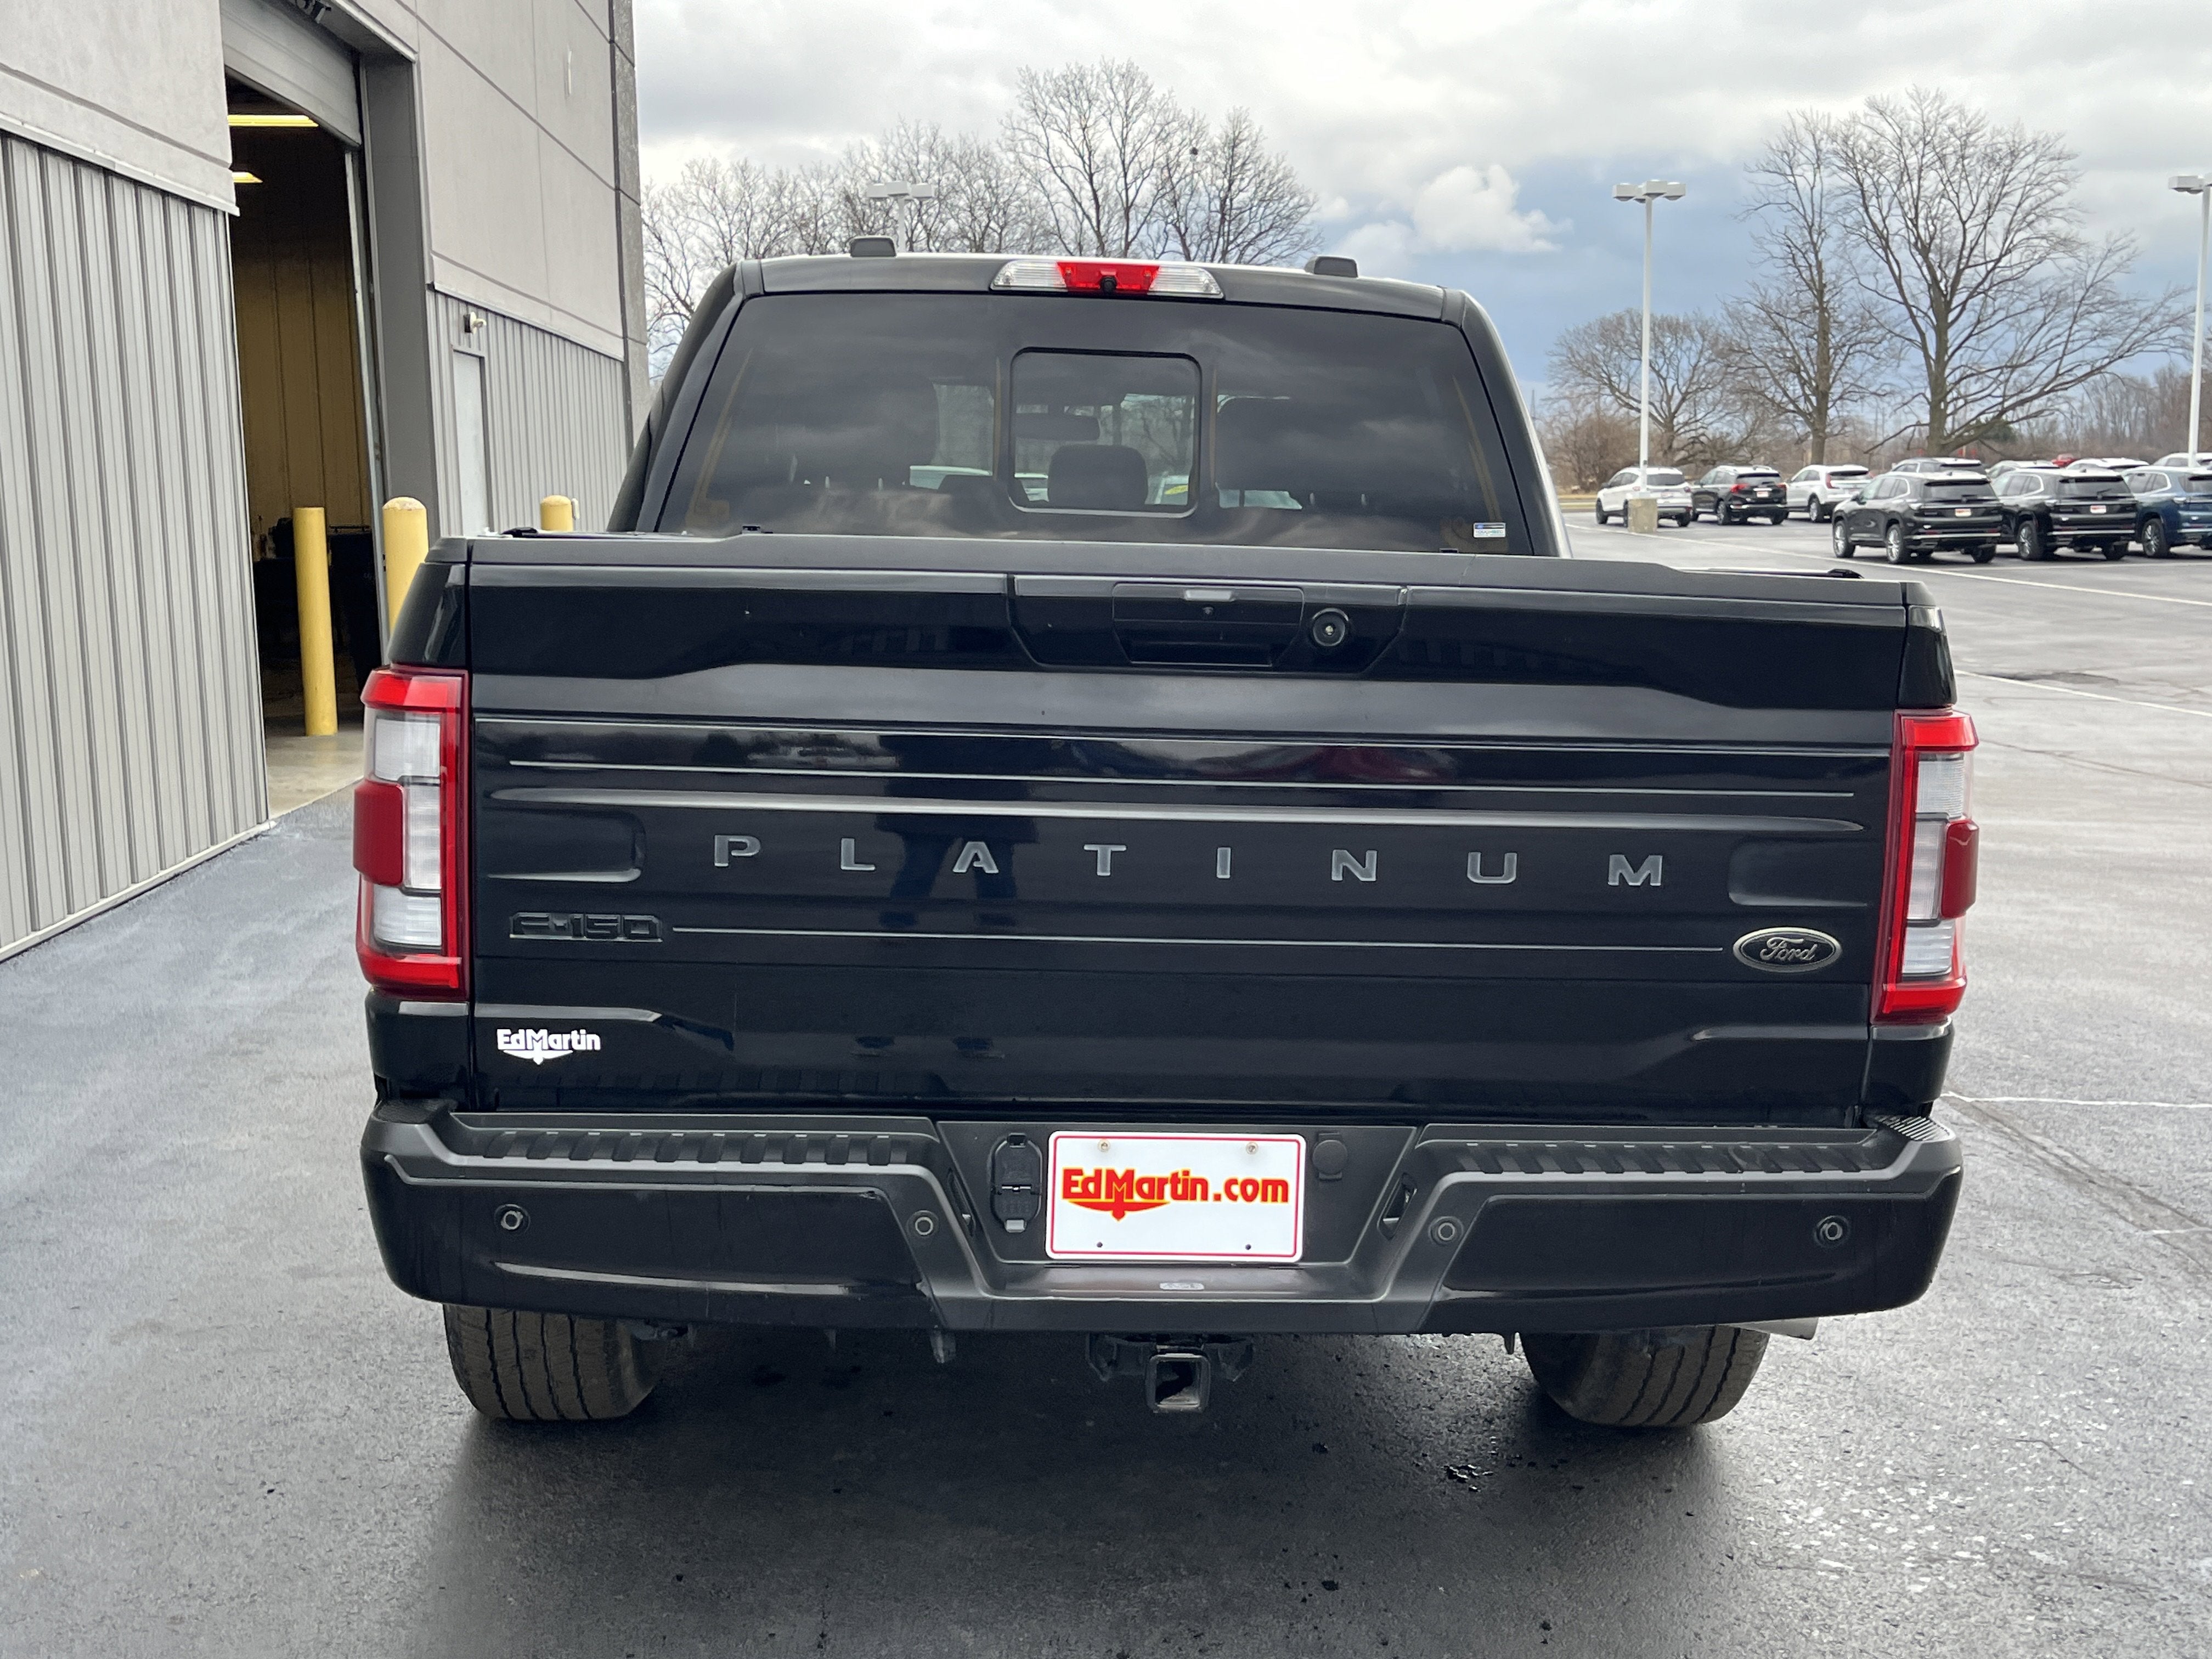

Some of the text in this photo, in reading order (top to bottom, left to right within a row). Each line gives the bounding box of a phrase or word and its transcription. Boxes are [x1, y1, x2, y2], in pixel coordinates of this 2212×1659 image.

[714, 834, 1663, 886] PLATINUM
[1760, 936, 1818, 961] Ford
[496, 1028, 601, 1051] EdMartin
[1062, 1166, 1289, 1203] EdMartin.com
